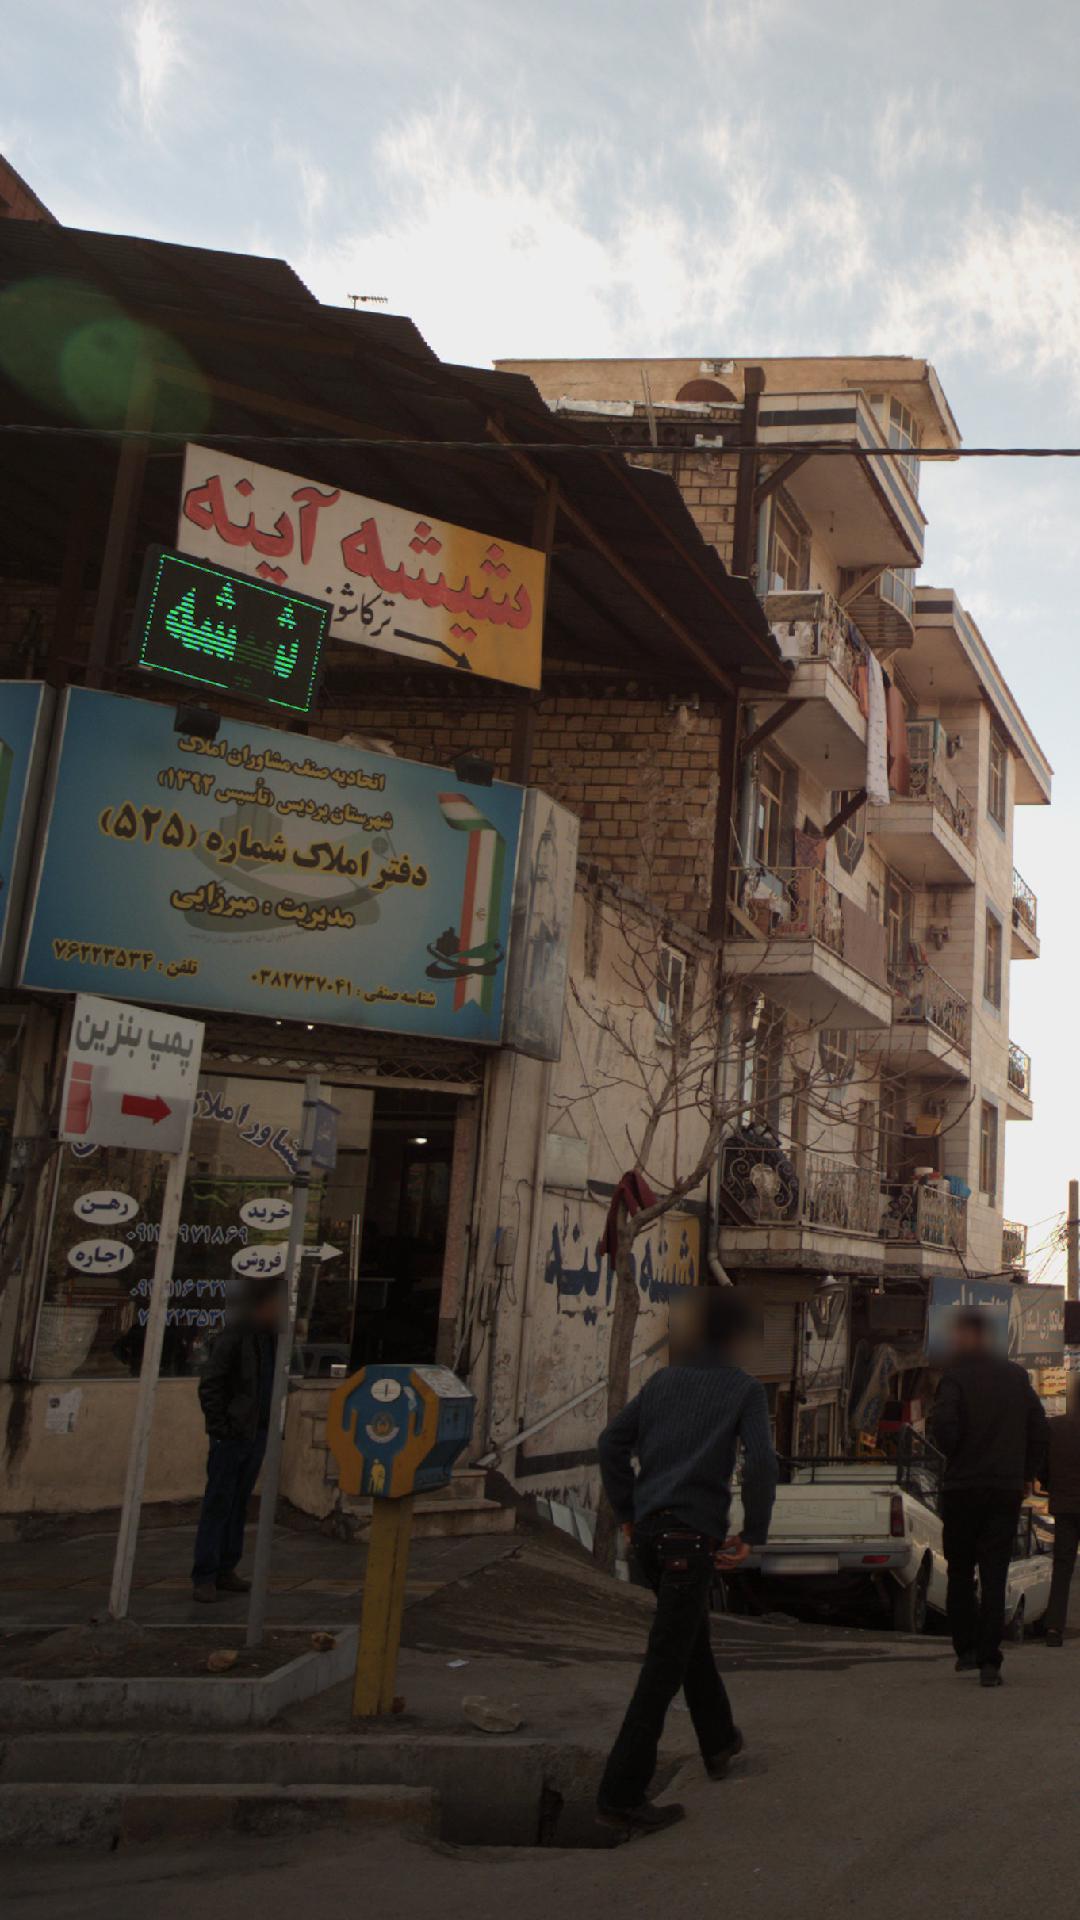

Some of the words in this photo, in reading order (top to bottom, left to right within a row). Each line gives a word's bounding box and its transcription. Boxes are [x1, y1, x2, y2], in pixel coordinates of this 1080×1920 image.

[183, 474, 341, 587] آینه
[341, 518, 533, 643] شیشه
[326, 583, 395, 636] ترکاشو
[178, 735, 228, 760] املاک
[226, 744, 293, 773] مشاوران
[292, 759, 329, 780] صنف
[332, 768, 385, 791] اتحادیه
[276, 799, 331, 824] پردیس
[330, 804, 393, 831] شهرستان
[204, 828, 288, 865] شماره
[292, 841, 371, 878] املاک
[369, 853, 428, 891] دفتر
[170, 879, 258, 917] میرزایی
[276, 897, 355, 930] مدیریت
[165, 958, 199, 977] تلفن
[75, 1013, 143, 1058] بنزین
[148, 1030, 194, 1077] پمپ
[80, 1197, 129, 1215] رهن
[247, 1203, 291, 1220] خرید
[75, 1247, 125, 1268] اجاره
[237, 1251, 282, 1273] فروش
